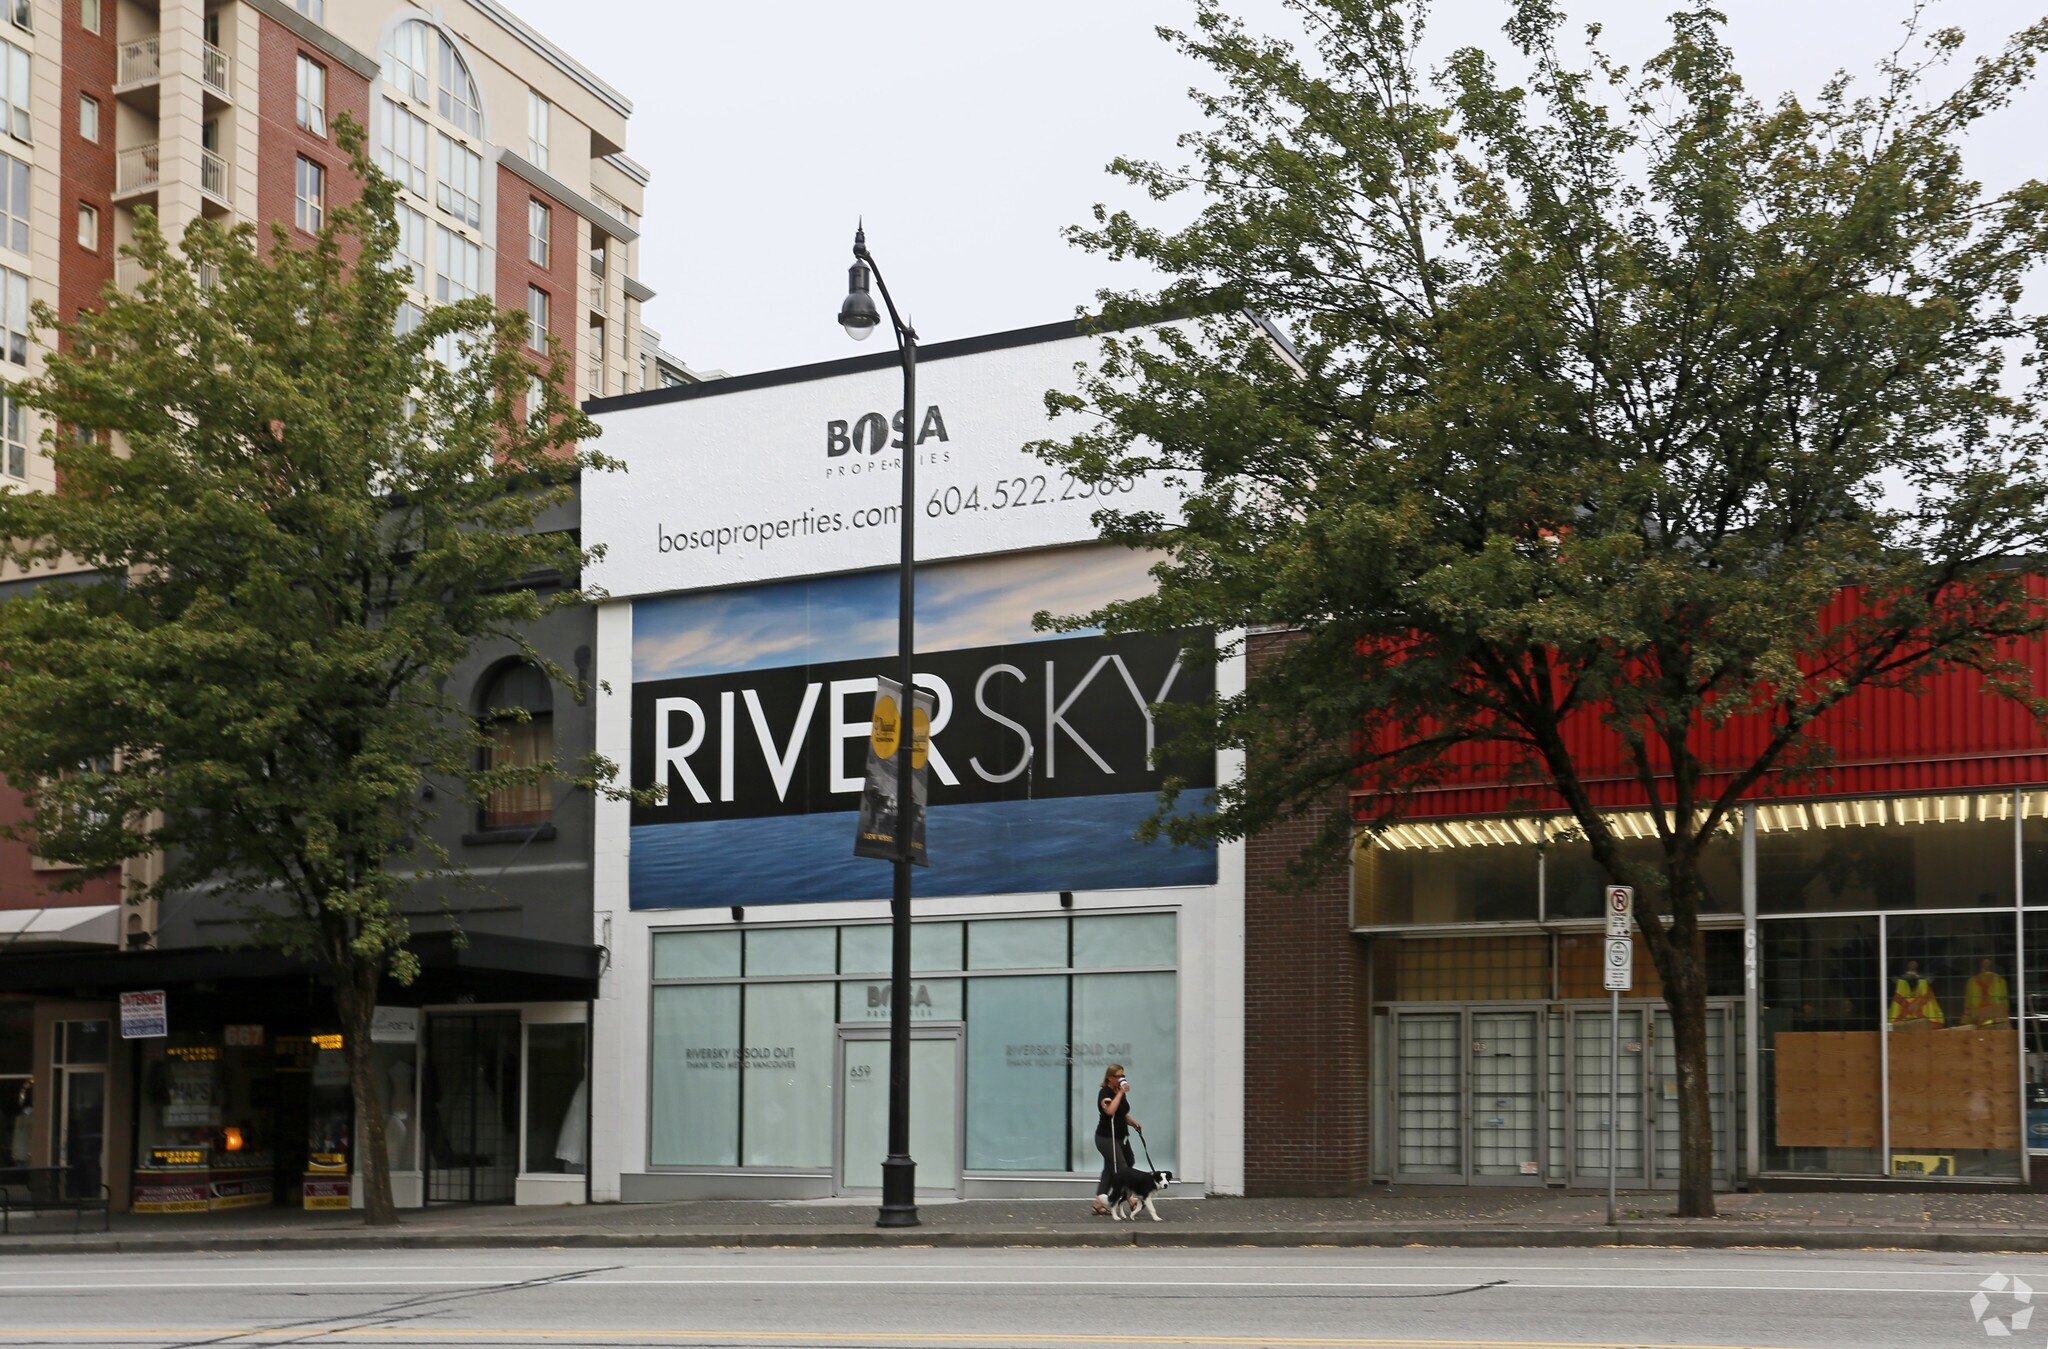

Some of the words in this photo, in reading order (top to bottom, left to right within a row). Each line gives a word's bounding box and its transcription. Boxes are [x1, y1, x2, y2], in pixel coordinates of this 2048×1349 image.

[827, 405, 949, 458] BOSA
[826, 451, 950, 479] PROPERIES
[658, 504, 903, 554] bosaproperties.com
[1744, 928, 1757, 989] 641
[225, 1026, 262, 1045] 667
[167, 1047, 216, 1056] WESTERN
[686, 1048, 729, 1059] RIVERSKY
[733, 1048, 743, 1059] IS
[744, 1047, 770, 1059] SOLD
[774, 1047, 795, 1058] OUT
[1006, 1044, 1057, 1056] RIVERSKY
[1074, 1043, 1104, 1055] SOLD
[1106, 1042, 1132, 1055] OUT
[182, 1054, 216, 1062] UNION
[687, 1061, 709, 1069] THANK
[710, 1061, 725, 1069] YOU
[753, 1060, 796, 1069] VANCOUVER
[850, 1065, 871, 1077] 659
[153, 1150, 201, 1158] WESTERN
[167, 1156, 200, 1164] UNION
